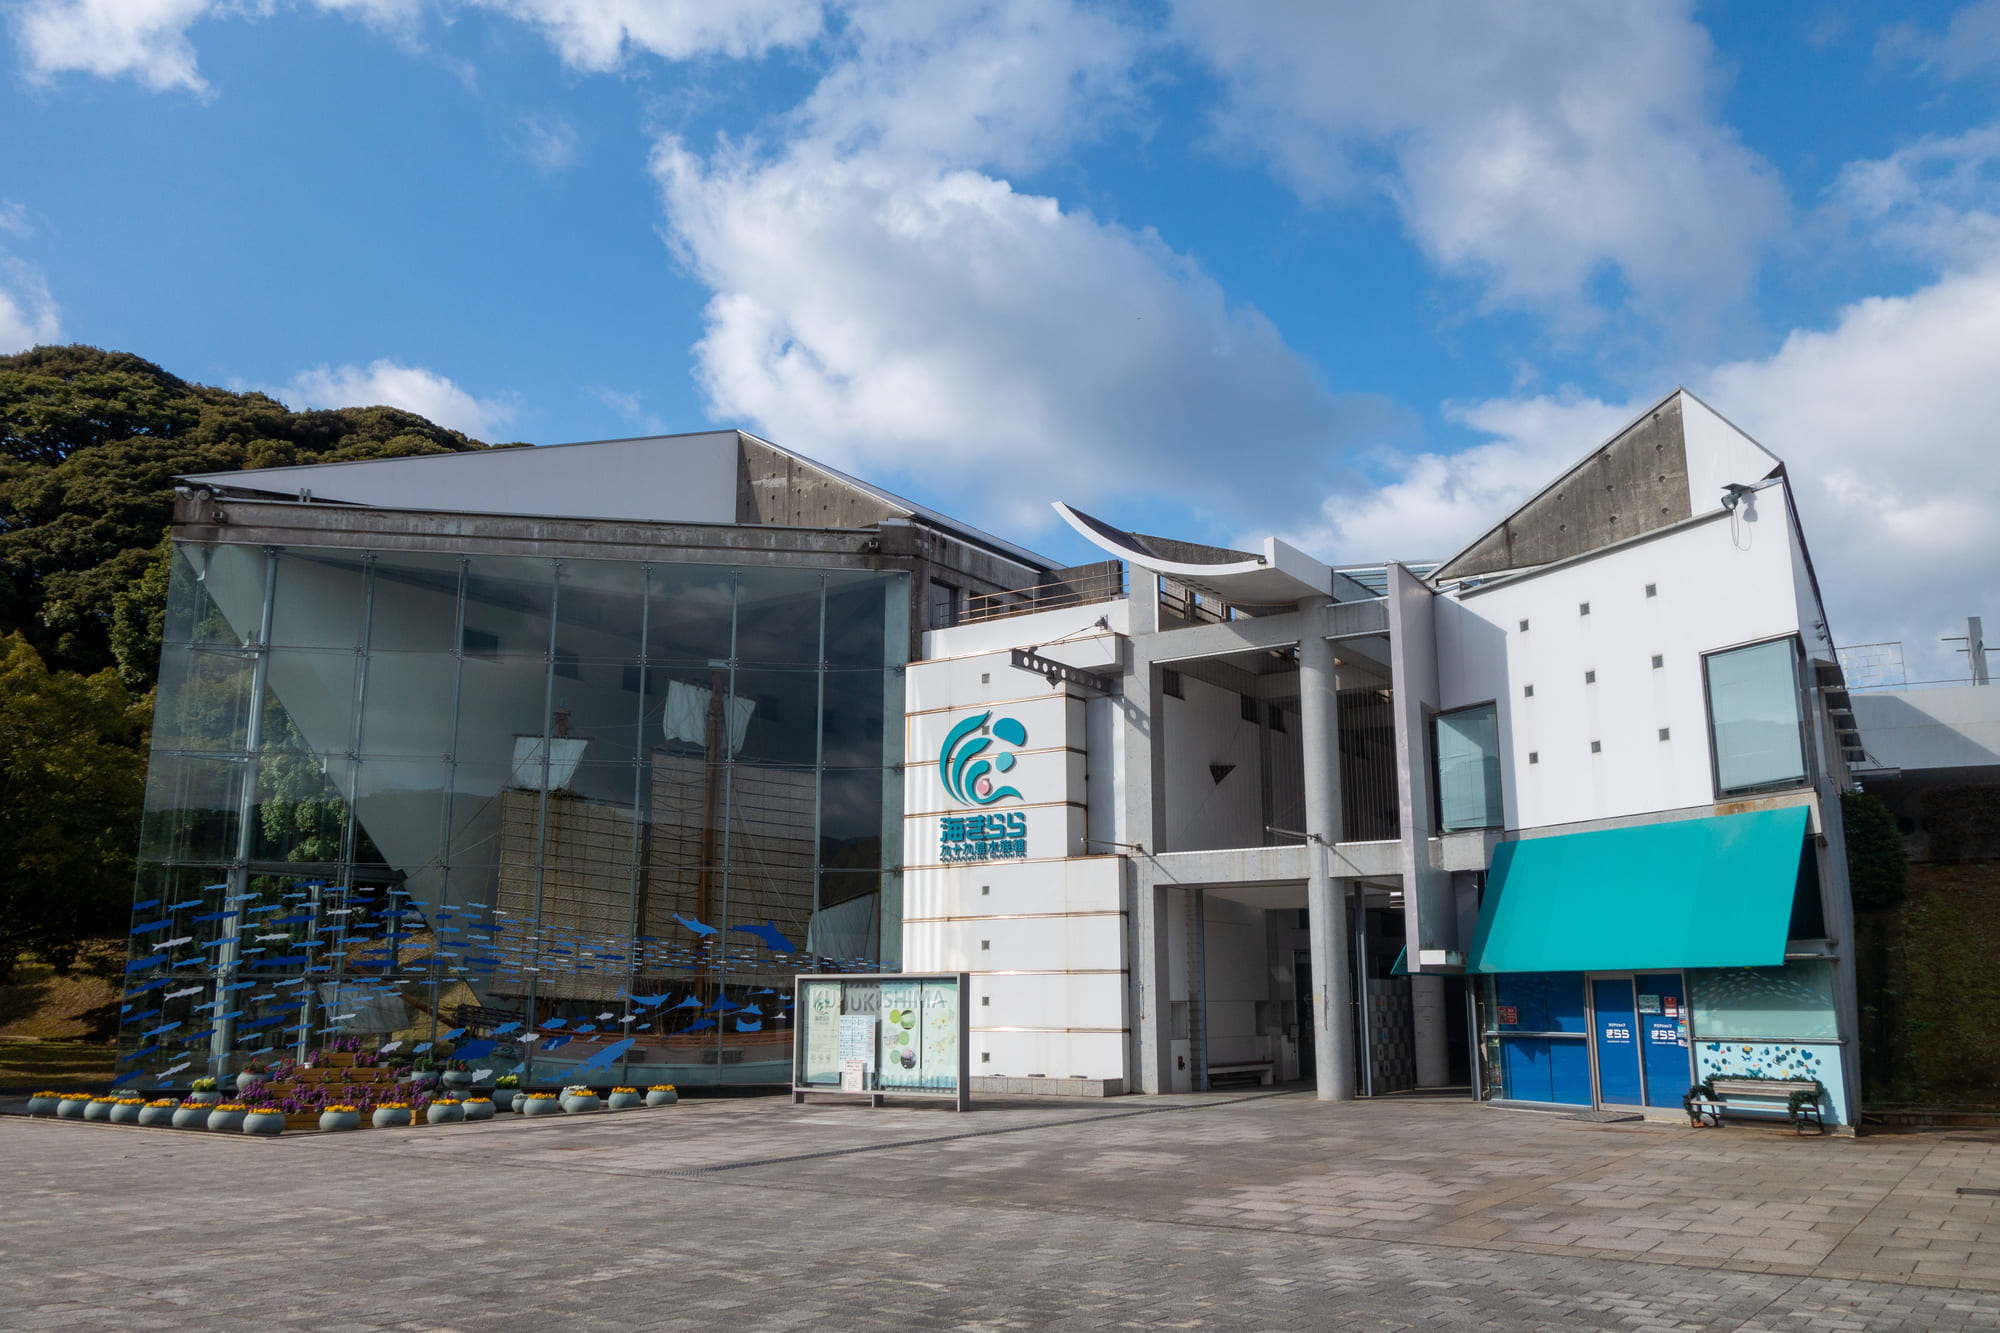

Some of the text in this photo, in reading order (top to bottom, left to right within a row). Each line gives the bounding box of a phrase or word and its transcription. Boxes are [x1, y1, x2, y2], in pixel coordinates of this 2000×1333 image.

[940, 812, 1025, 841] 海きらら
[939, 839, 1025, 856] 九十九島水族館
[1606, 1029, 1630, 1039] きらら
[1651, 1030, 1677, 1040] きらら
